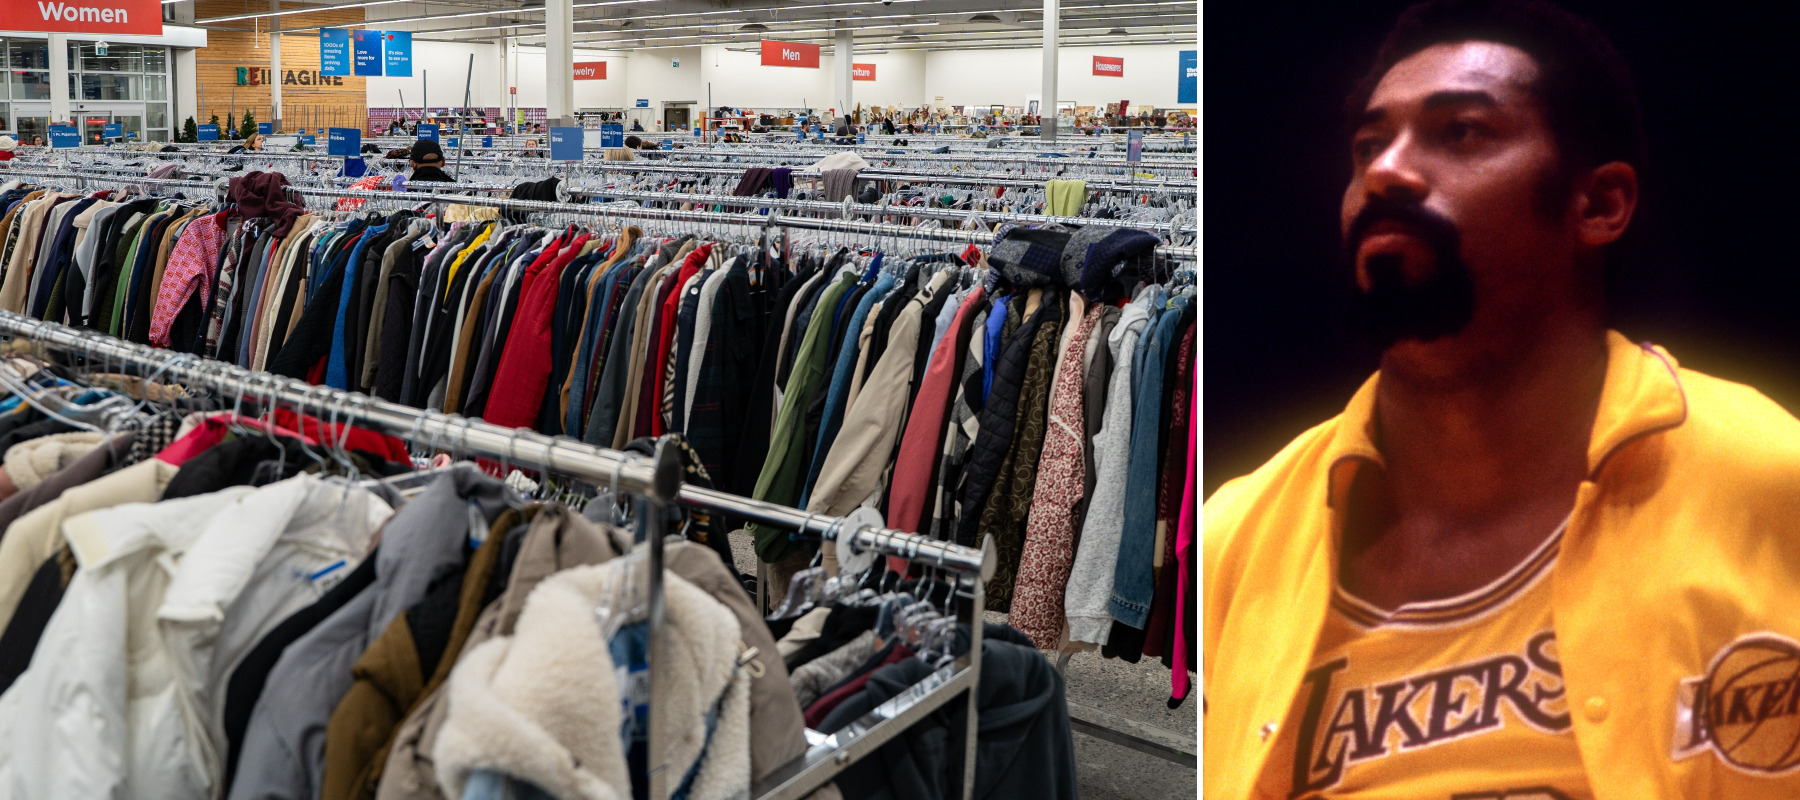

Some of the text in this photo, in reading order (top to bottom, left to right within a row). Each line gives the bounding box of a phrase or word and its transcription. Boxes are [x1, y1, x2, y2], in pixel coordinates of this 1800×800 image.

[38, 1, 128, 24] Women
[782, 48, 800, 61] Men
[1095, 61, 1122, 72] Housewares
[1287, 630, 1573, 799] LAKERS
